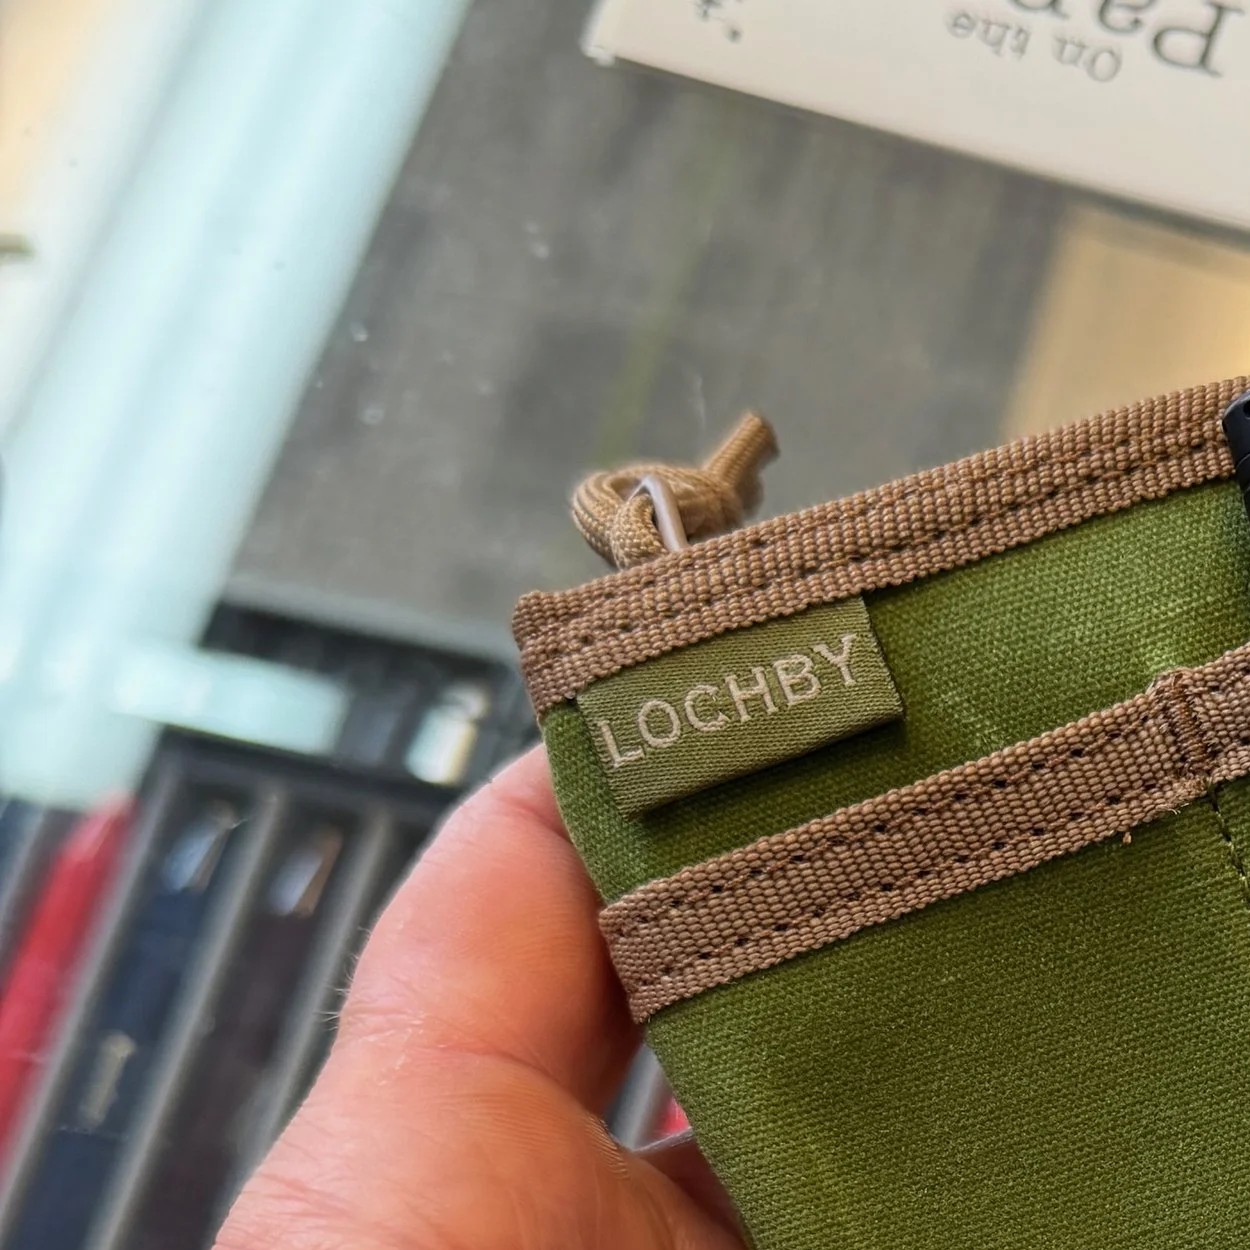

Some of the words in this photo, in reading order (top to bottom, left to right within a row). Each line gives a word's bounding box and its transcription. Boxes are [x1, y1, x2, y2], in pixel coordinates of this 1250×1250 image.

[949, 10, 1031, 60] the
[1053, 35, 1123, 83] On
[598, 632, 858, 768] LOCHBY
